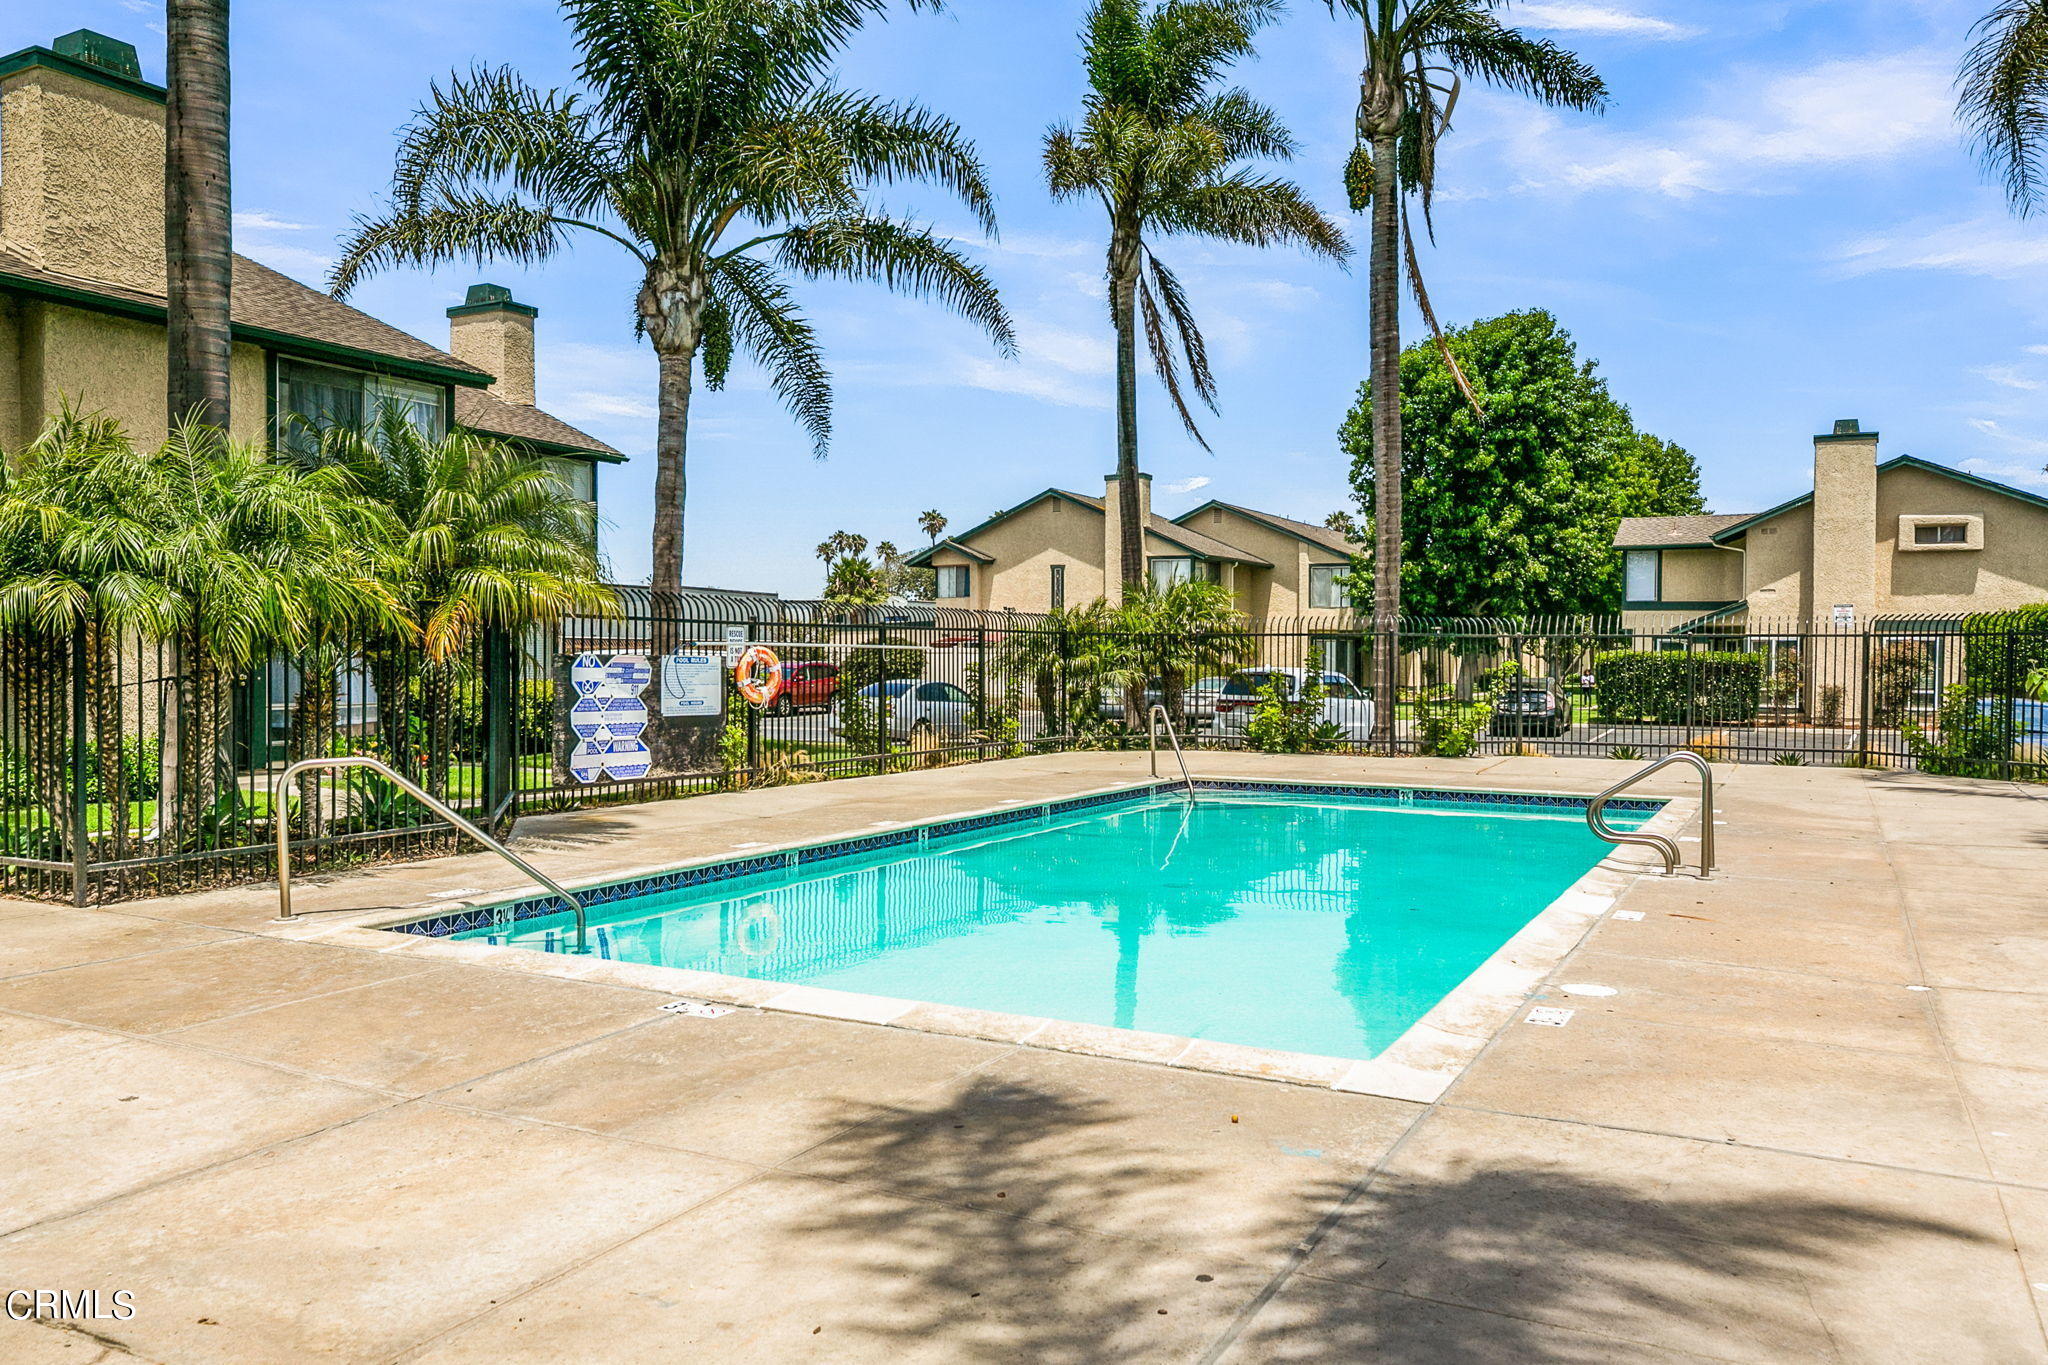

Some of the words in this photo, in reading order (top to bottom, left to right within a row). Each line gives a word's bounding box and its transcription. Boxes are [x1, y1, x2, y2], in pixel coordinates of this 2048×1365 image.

[728, 630, 743, 638] RESCUE
[582, 655, 595, 667] NO
[613, 740, 639, 752] WARNING
